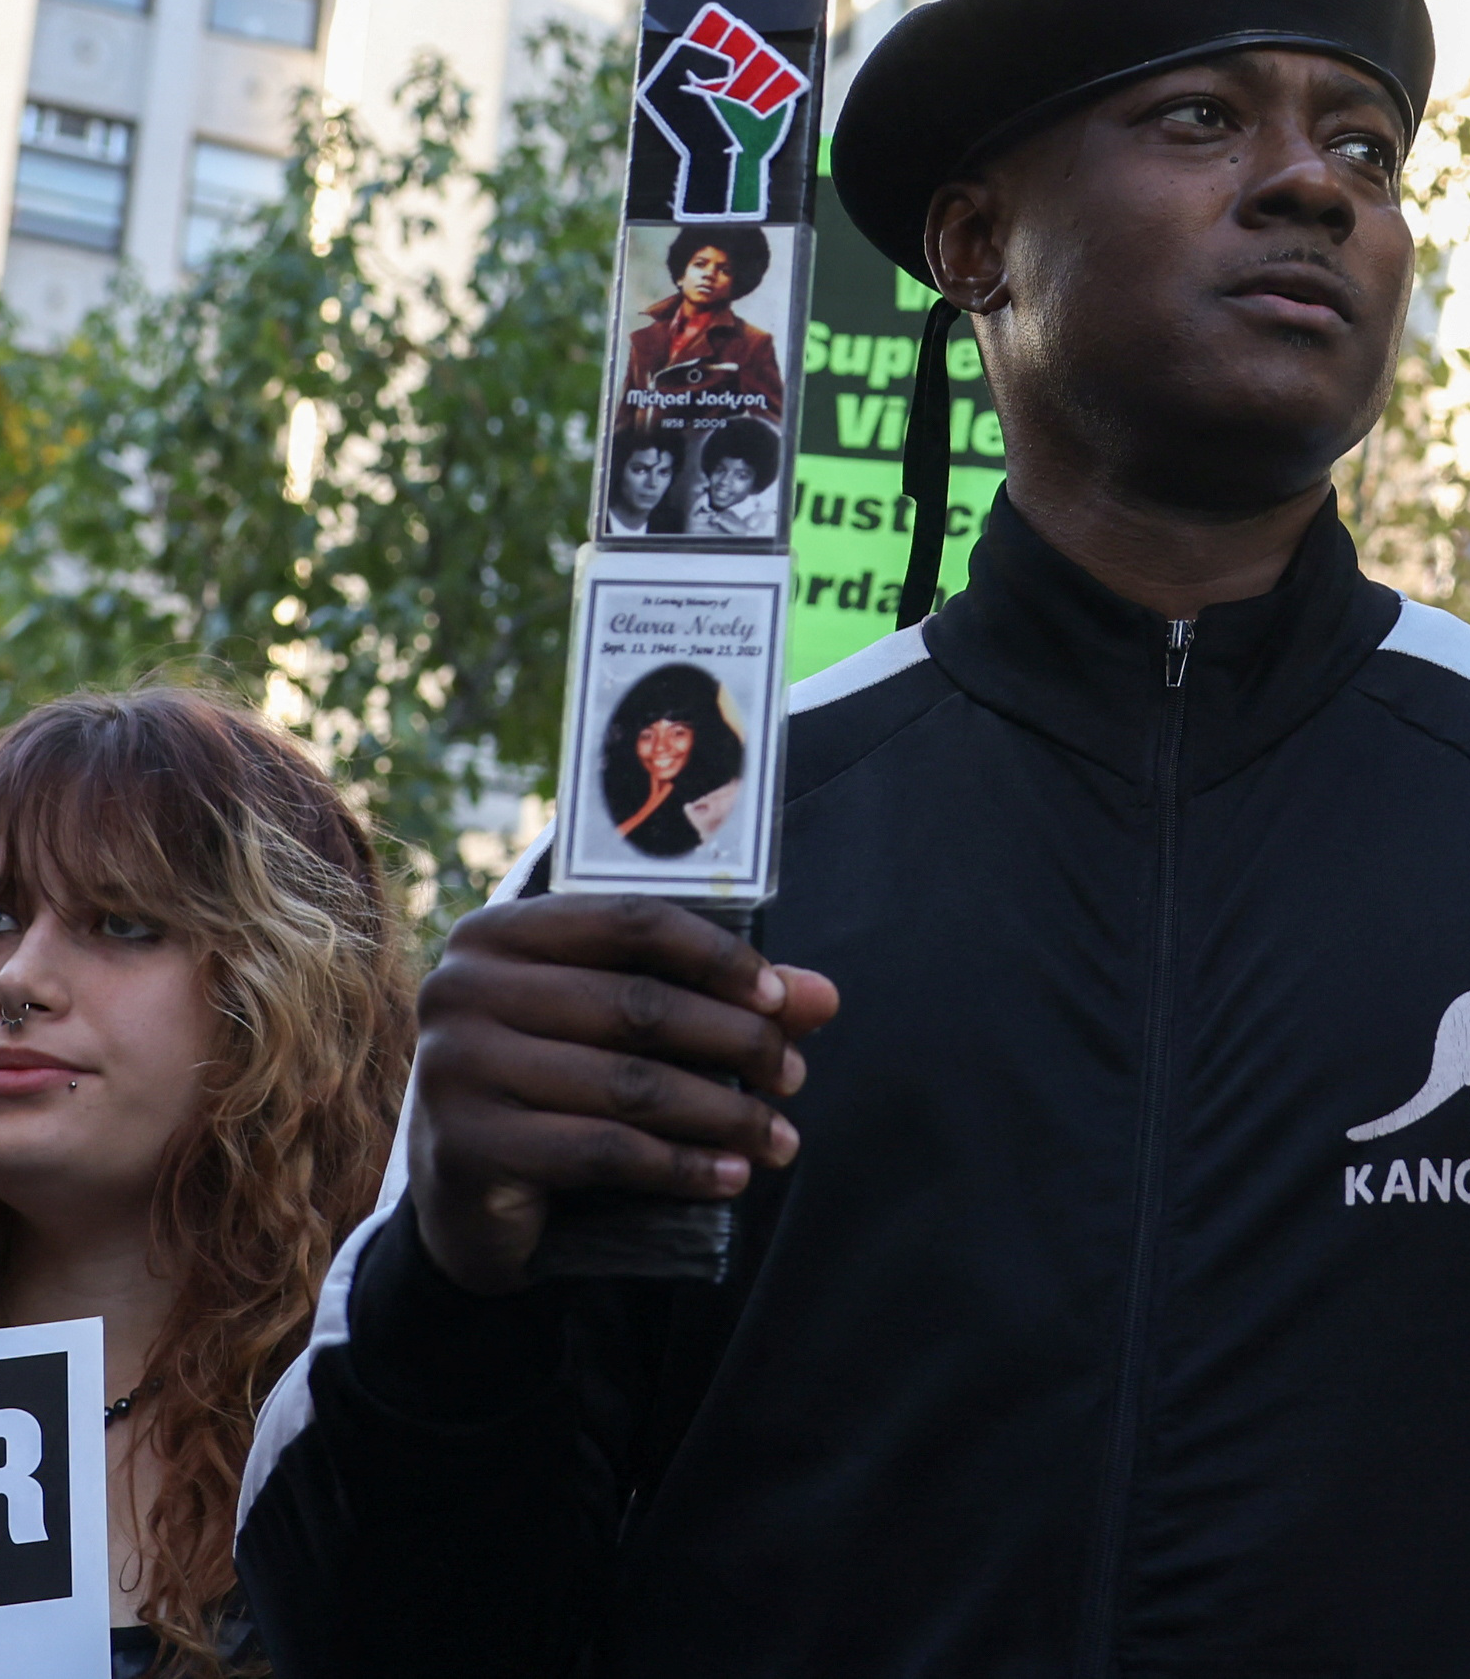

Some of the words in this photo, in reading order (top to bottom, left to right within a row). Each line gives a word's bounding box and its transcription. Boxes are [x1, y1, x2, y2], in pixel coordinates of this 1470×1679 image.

[626, 389, 691, 409] Michael
[695, 390, 768, 410] Jackson
[660, 418, 685, 428] 1958
[693, 418, 727, 429] 2009
[610, 613, 675, 634] Clara
[684, 614, 755, 642] Neely
